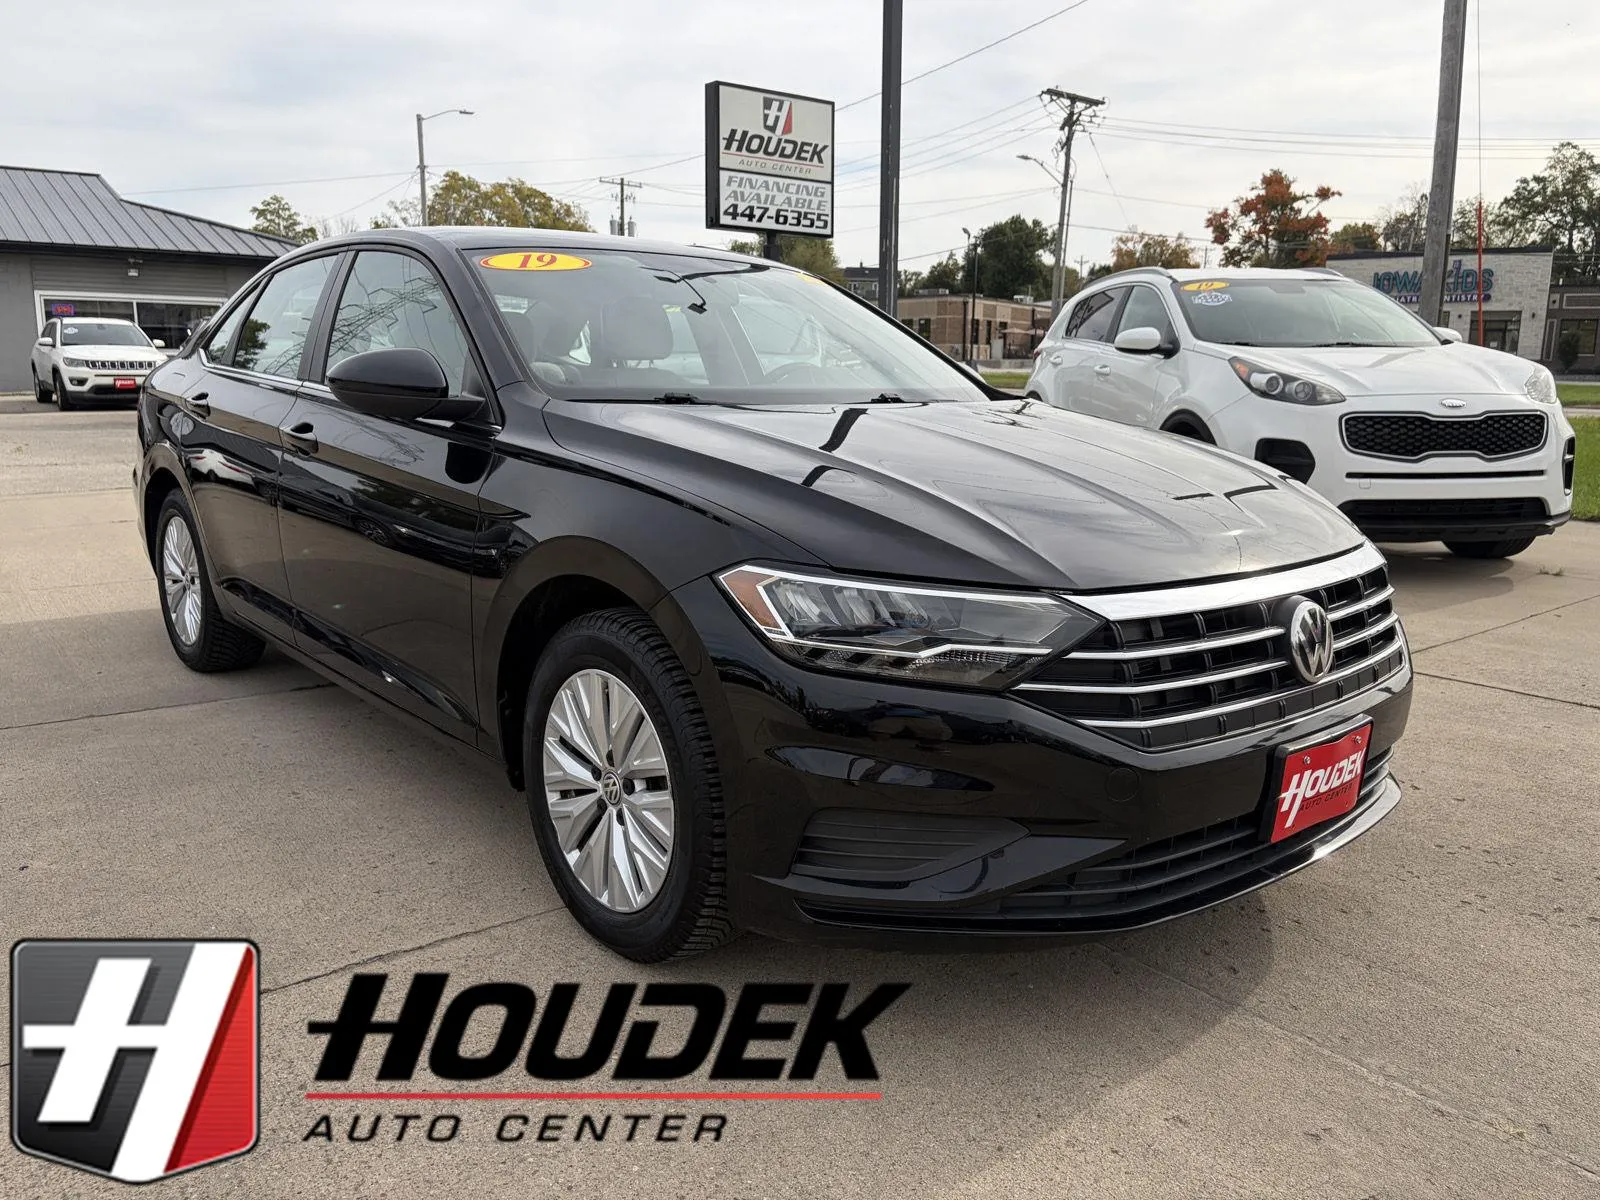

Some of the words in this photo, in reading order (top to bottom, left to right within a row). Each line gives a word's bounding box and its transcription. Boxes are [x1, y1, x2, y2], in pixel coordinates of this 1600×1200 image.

[722, 128, 829, 164] HOUDEK
[738, 158, 767, 169] AUTO
[771, 164, 811, 175] CENTER
[725, 175, 826, 198] FINANCING
[724, 189, 828, 212] AVAILABLE
[722, 203, 829, 230] 447-6355
[518, 254, 558, 269] 19
[1446, 259, 1494, 293] IDS
[1443, 293, 1485, 303] NTISTR
[1276, 746, 1367, 828] HOUDEK
[1299, 797, 1322, 812] AUTO
[1324, 783, 1353, 802] CENTER
